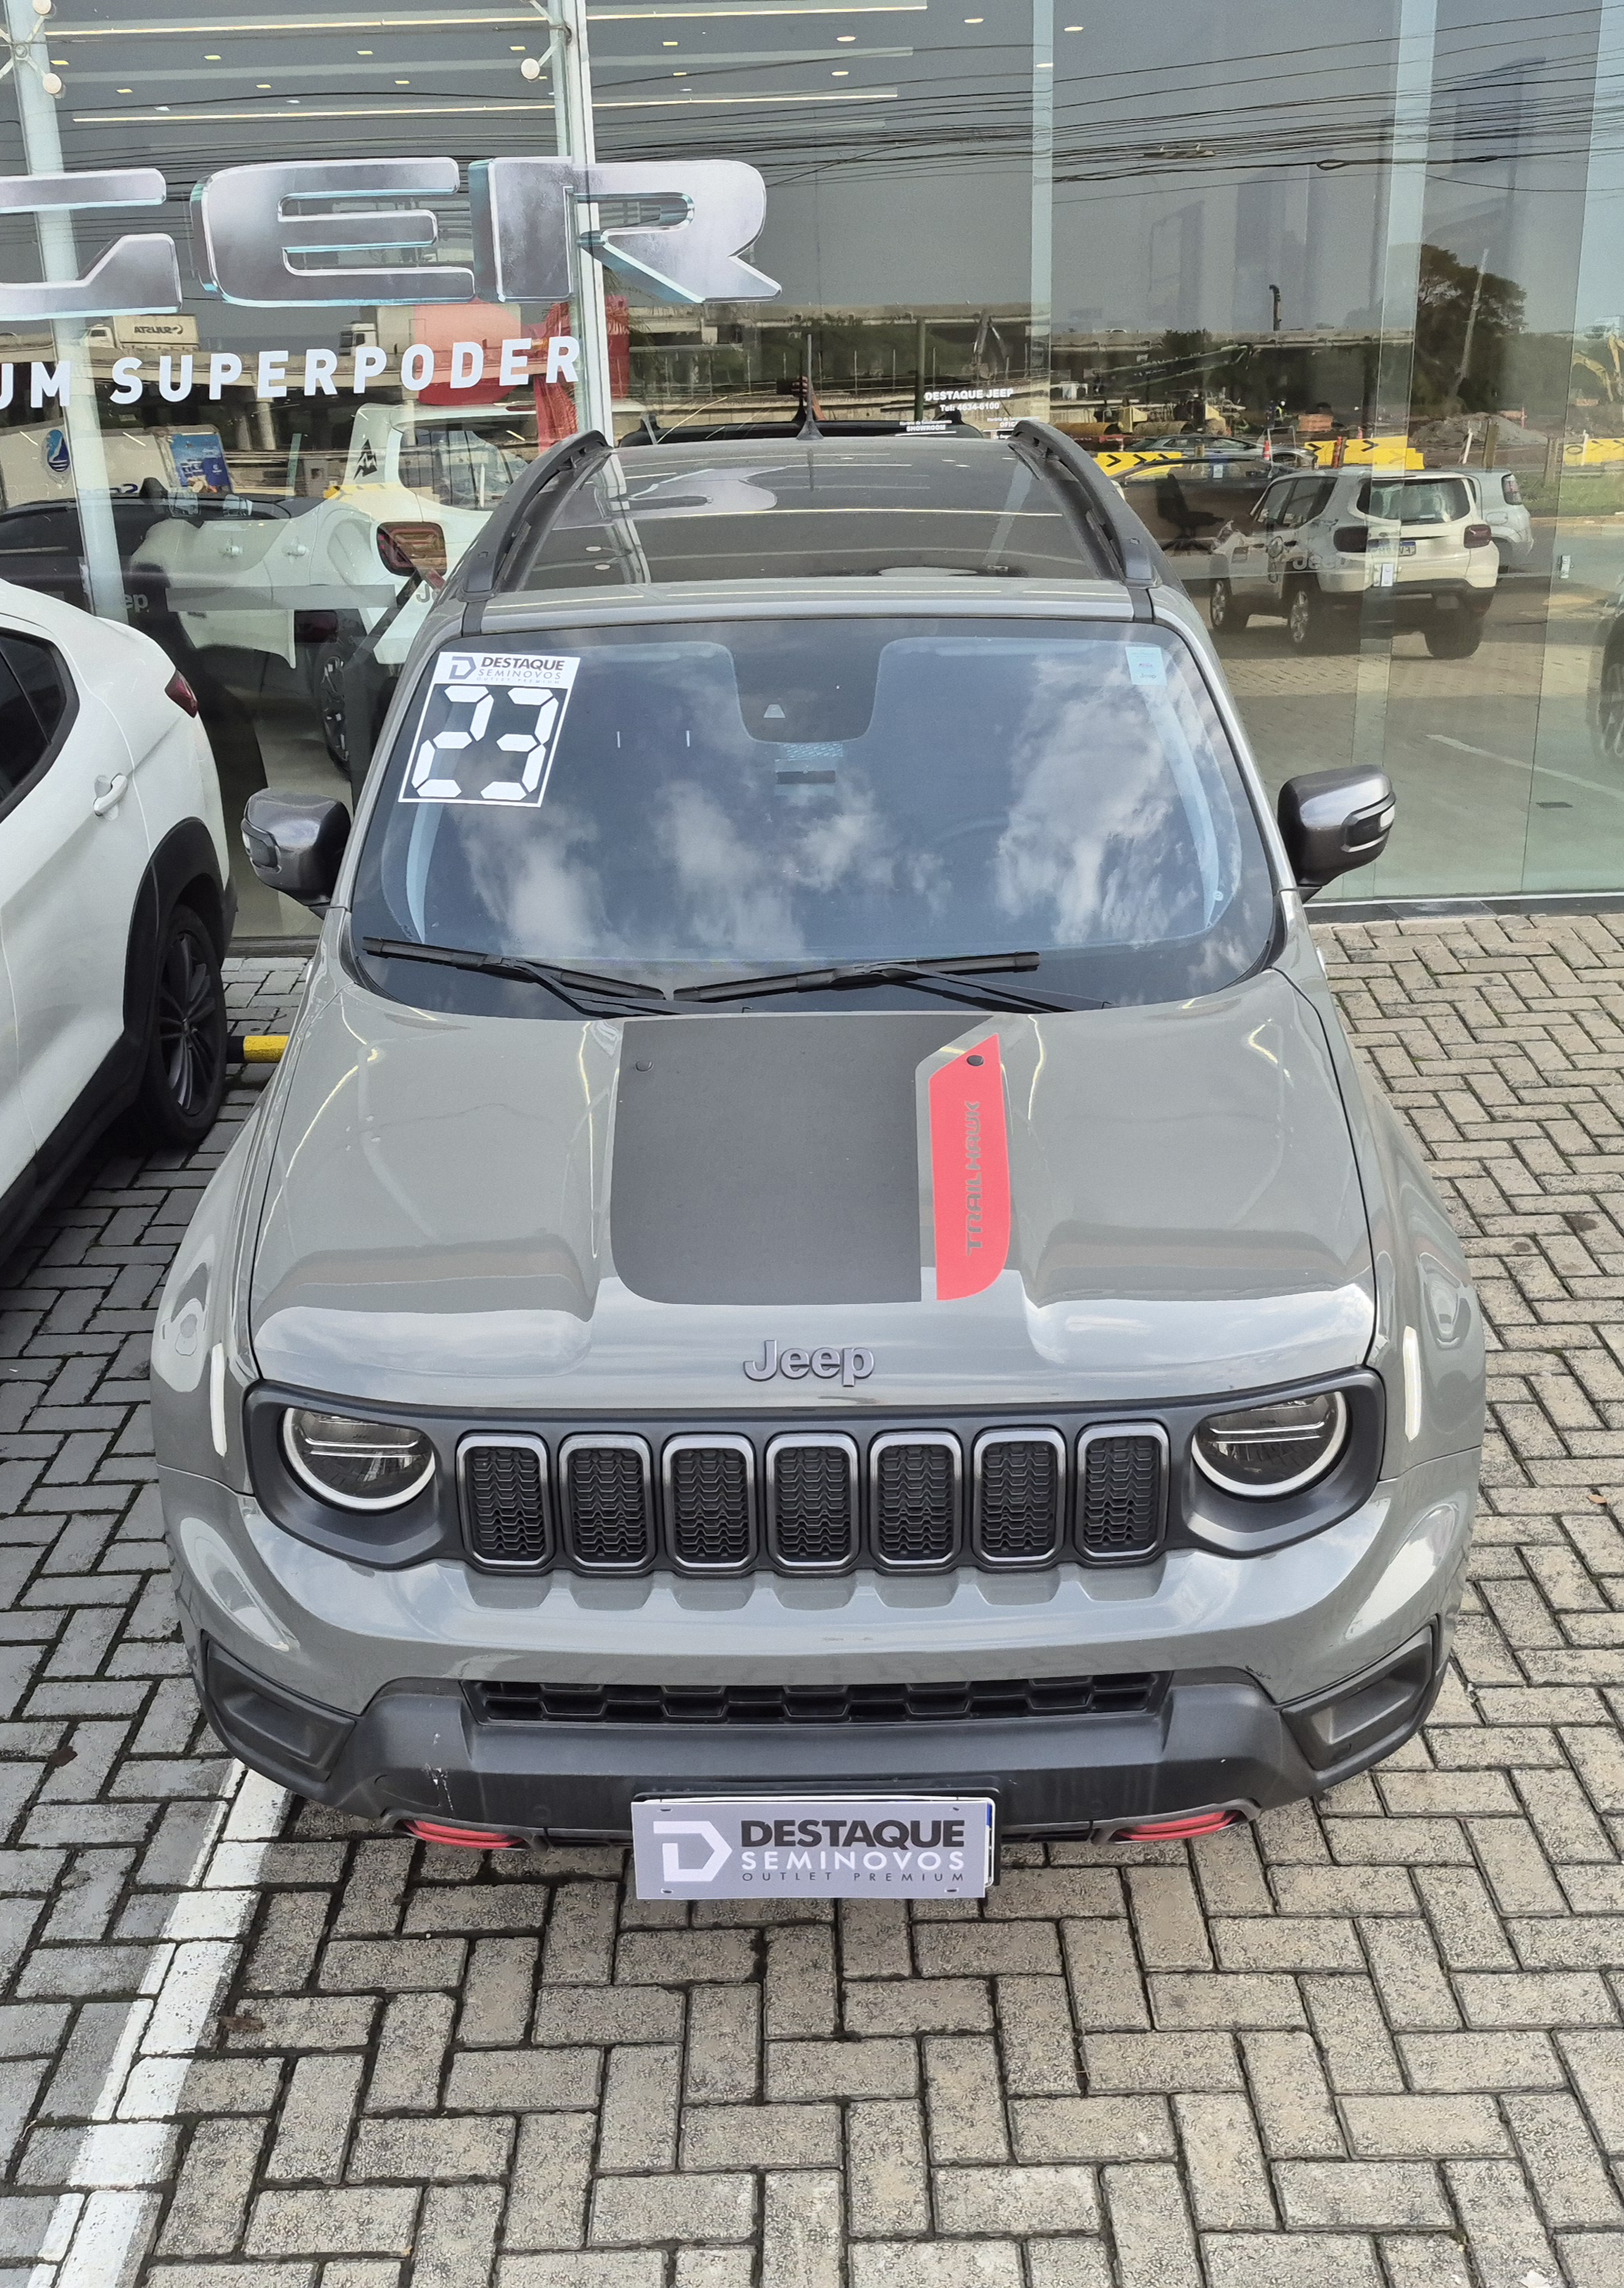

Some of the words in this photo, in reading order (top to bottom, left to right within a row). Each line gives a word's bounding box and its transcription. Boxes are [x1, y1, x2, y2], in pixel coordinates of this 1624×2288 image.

[110, 336, 580, 404] SUPERPODER
[924, 390, 984, 401] DESTAQUE
[986, 388, 1013, 398] JEEP
[479, 669, 561, 680] SEMINOVOS
[481, 657, 565, 670] DESTAQUE
[411, 686, 559, 801] 23
[964, 1100, 984, 1257] TRAILHAWK
[743, 1339, 875, 1387] Jeep
[740, 1819, 965, 1851] DESTAQUE
[741, 1850, 964, 1871] SEMINOVOS
[742, 1872, 833, 1881] OUTLET
[853, 1872, 964, 1882] PREMIUM
